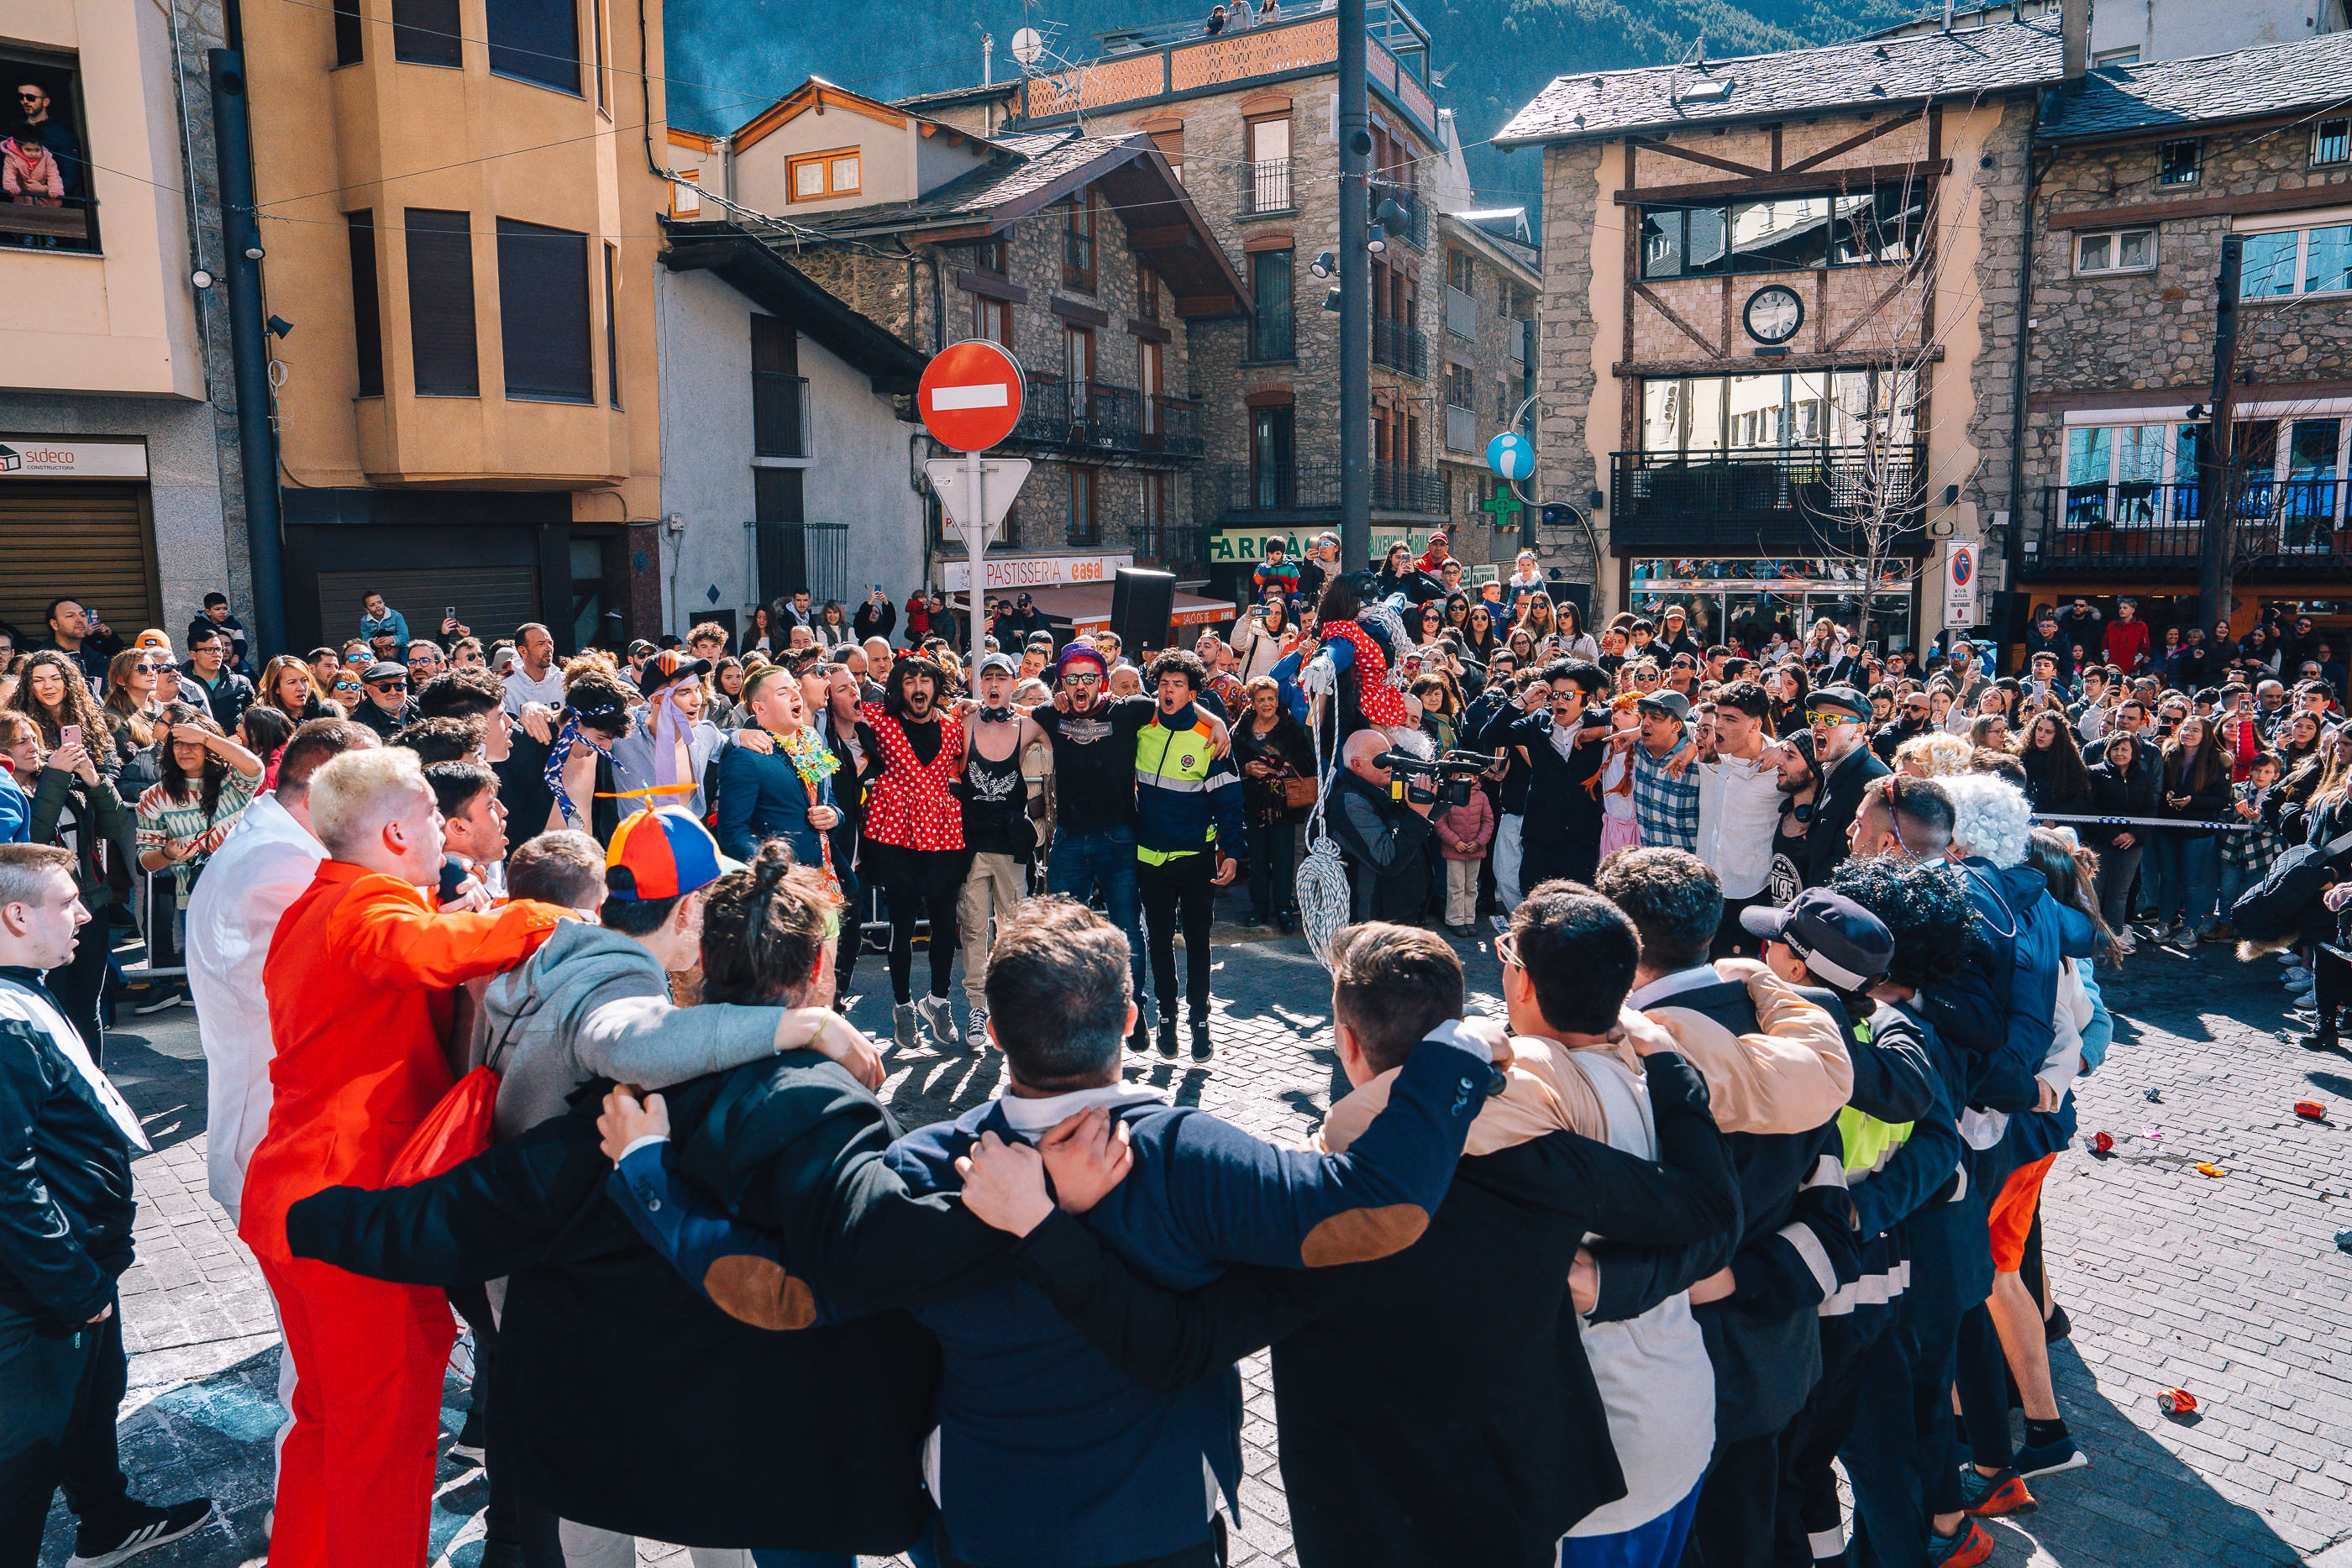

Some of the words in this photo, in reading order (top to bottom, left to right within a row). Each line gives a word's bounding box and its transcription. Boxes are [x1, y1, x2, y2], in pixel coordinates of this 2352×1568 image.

[25, 448, 75, 463] sideco
[987, 561, 1061, 586] PASTISSERIA
[1782, 931, 1810, 958] CIRCULACIÓ
